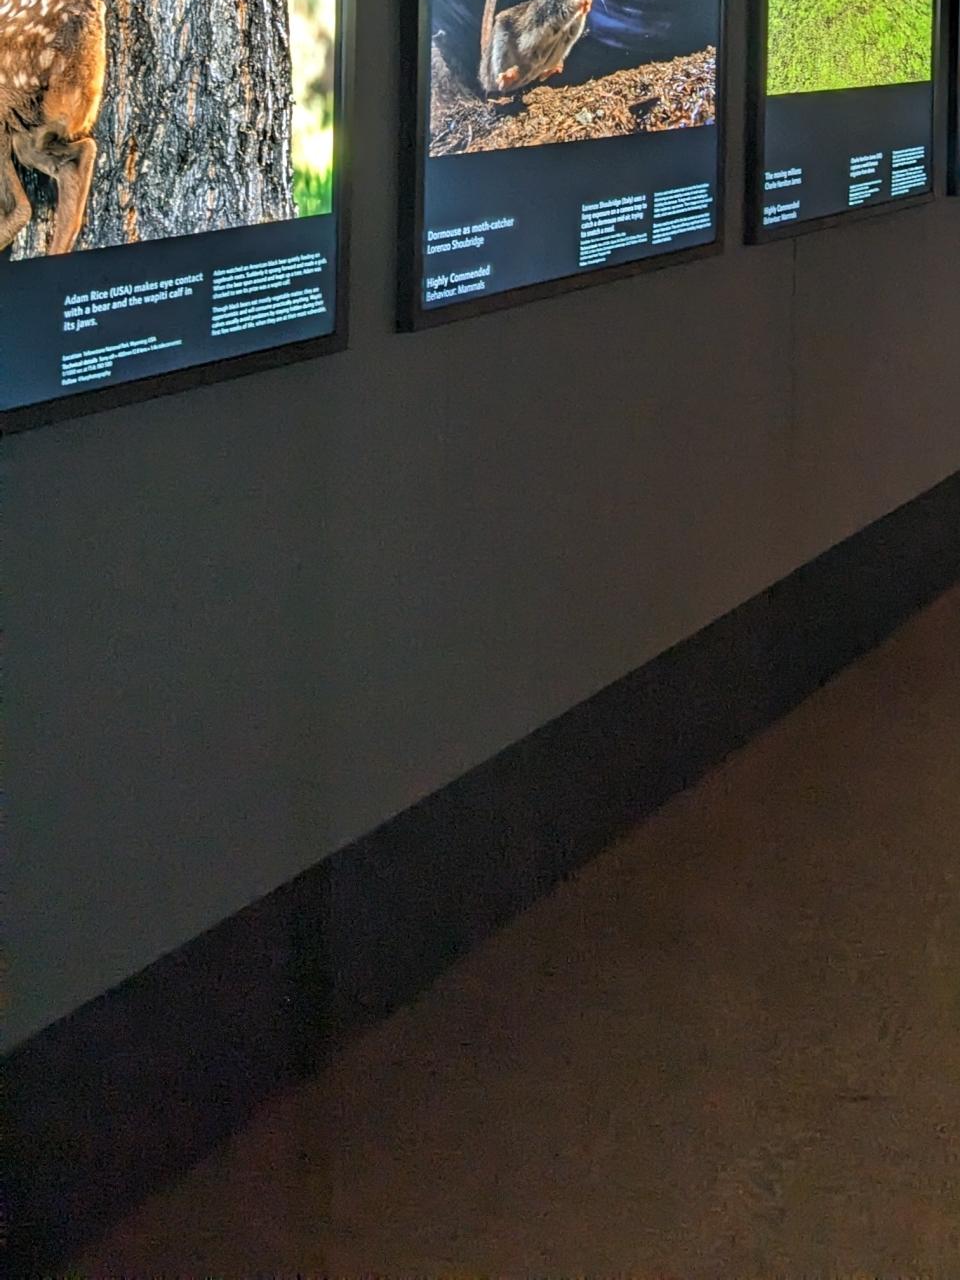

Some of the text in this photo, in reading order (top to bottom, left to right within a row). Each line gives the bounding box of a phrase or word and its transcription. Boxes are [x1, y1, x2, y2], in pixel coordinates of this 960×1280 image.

[427, 218, 515, 241] Dormouse as moth-catcher
[427, 236, 485, 254] Lorenzo Shoubridge
[426, 265, 491, 289] Highly Commended
[457, 281, 485, 294] Mammals
[64, 272, 204, 306] Adam Rice (USA) makes eye contact
[64, 287, 193, 318] with a bear and the wapiti calf in
[63, 318, 98, 331] its jaws.
